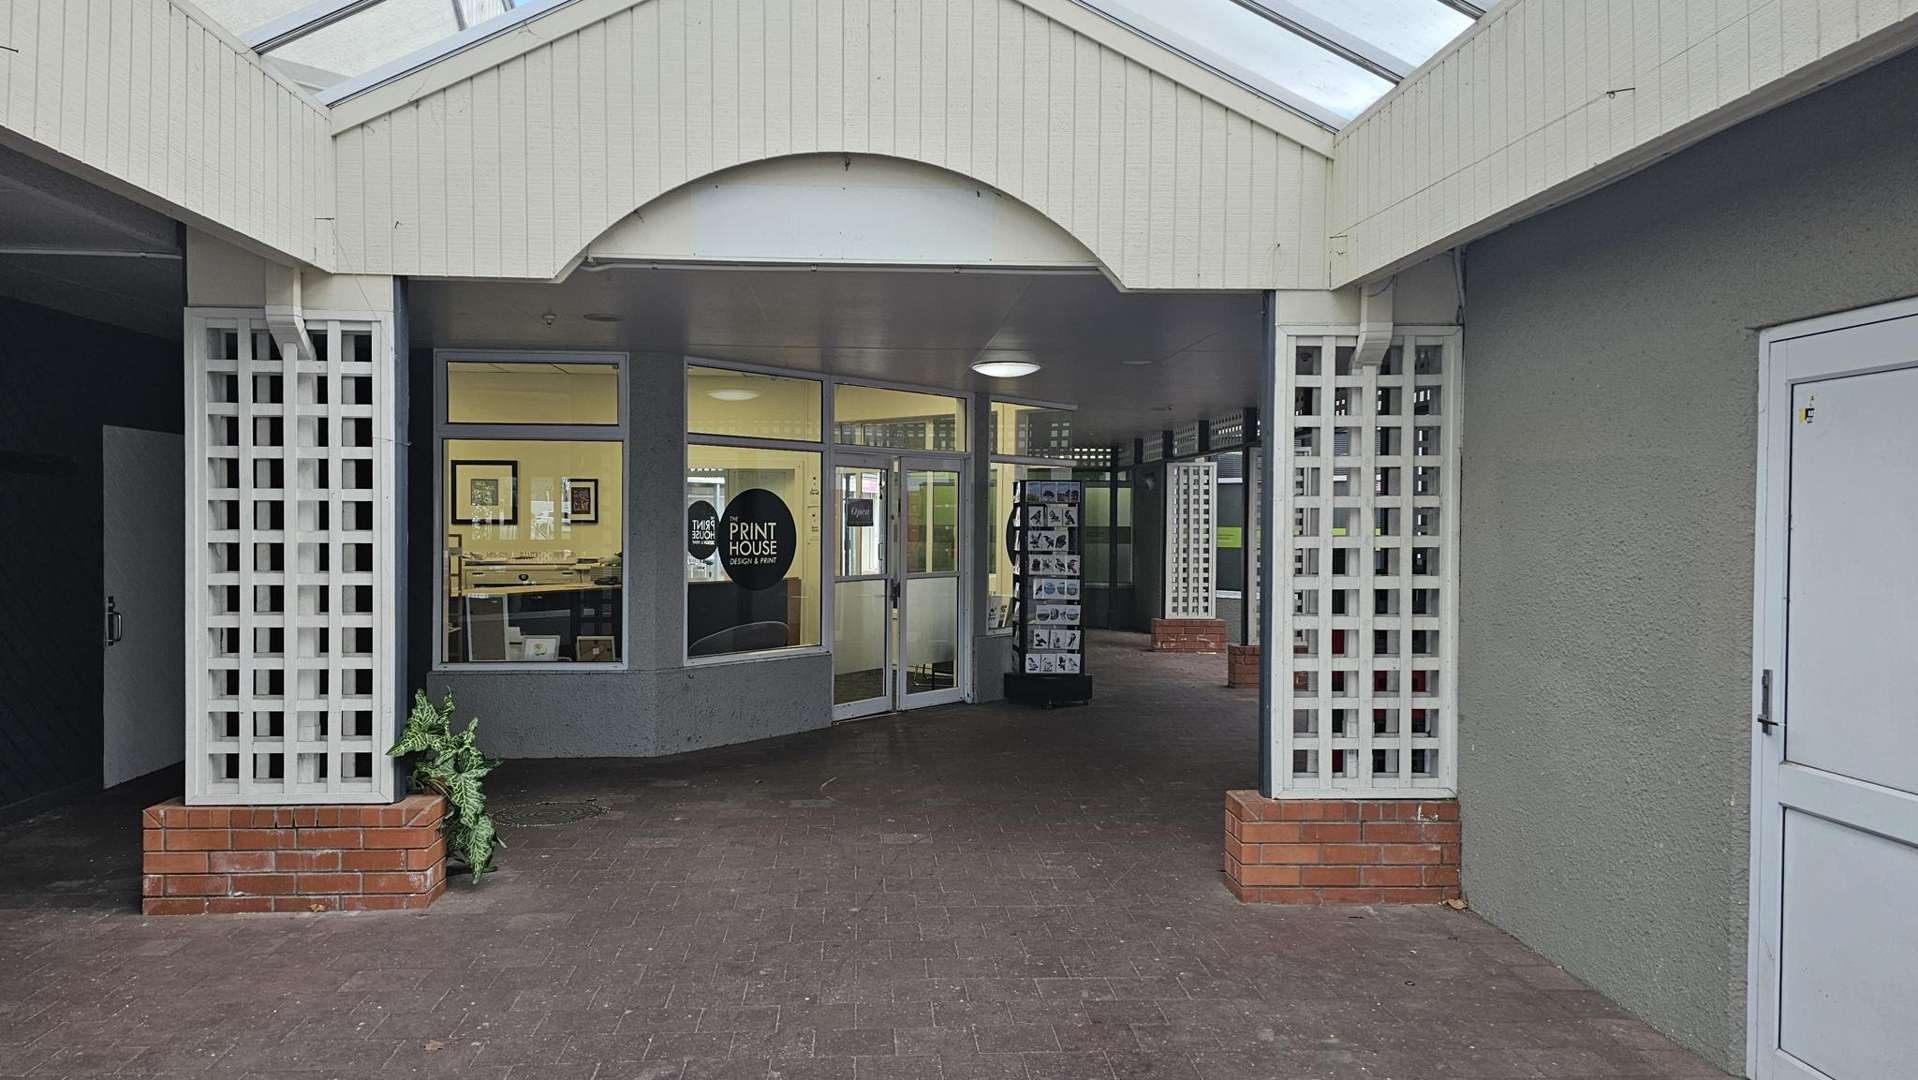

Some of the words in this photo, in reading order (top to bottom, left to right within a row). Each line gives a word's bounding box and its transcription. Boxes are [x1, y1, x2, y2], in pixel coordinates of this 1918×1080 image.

[729, 522, 777, 540] PRINT
[729, 540, 777, 556] HOUSE
[729, 557, 753, 565] DESIGN
[754, 557, 759, 565] &
[760, 556, 777, 564] PRINT
